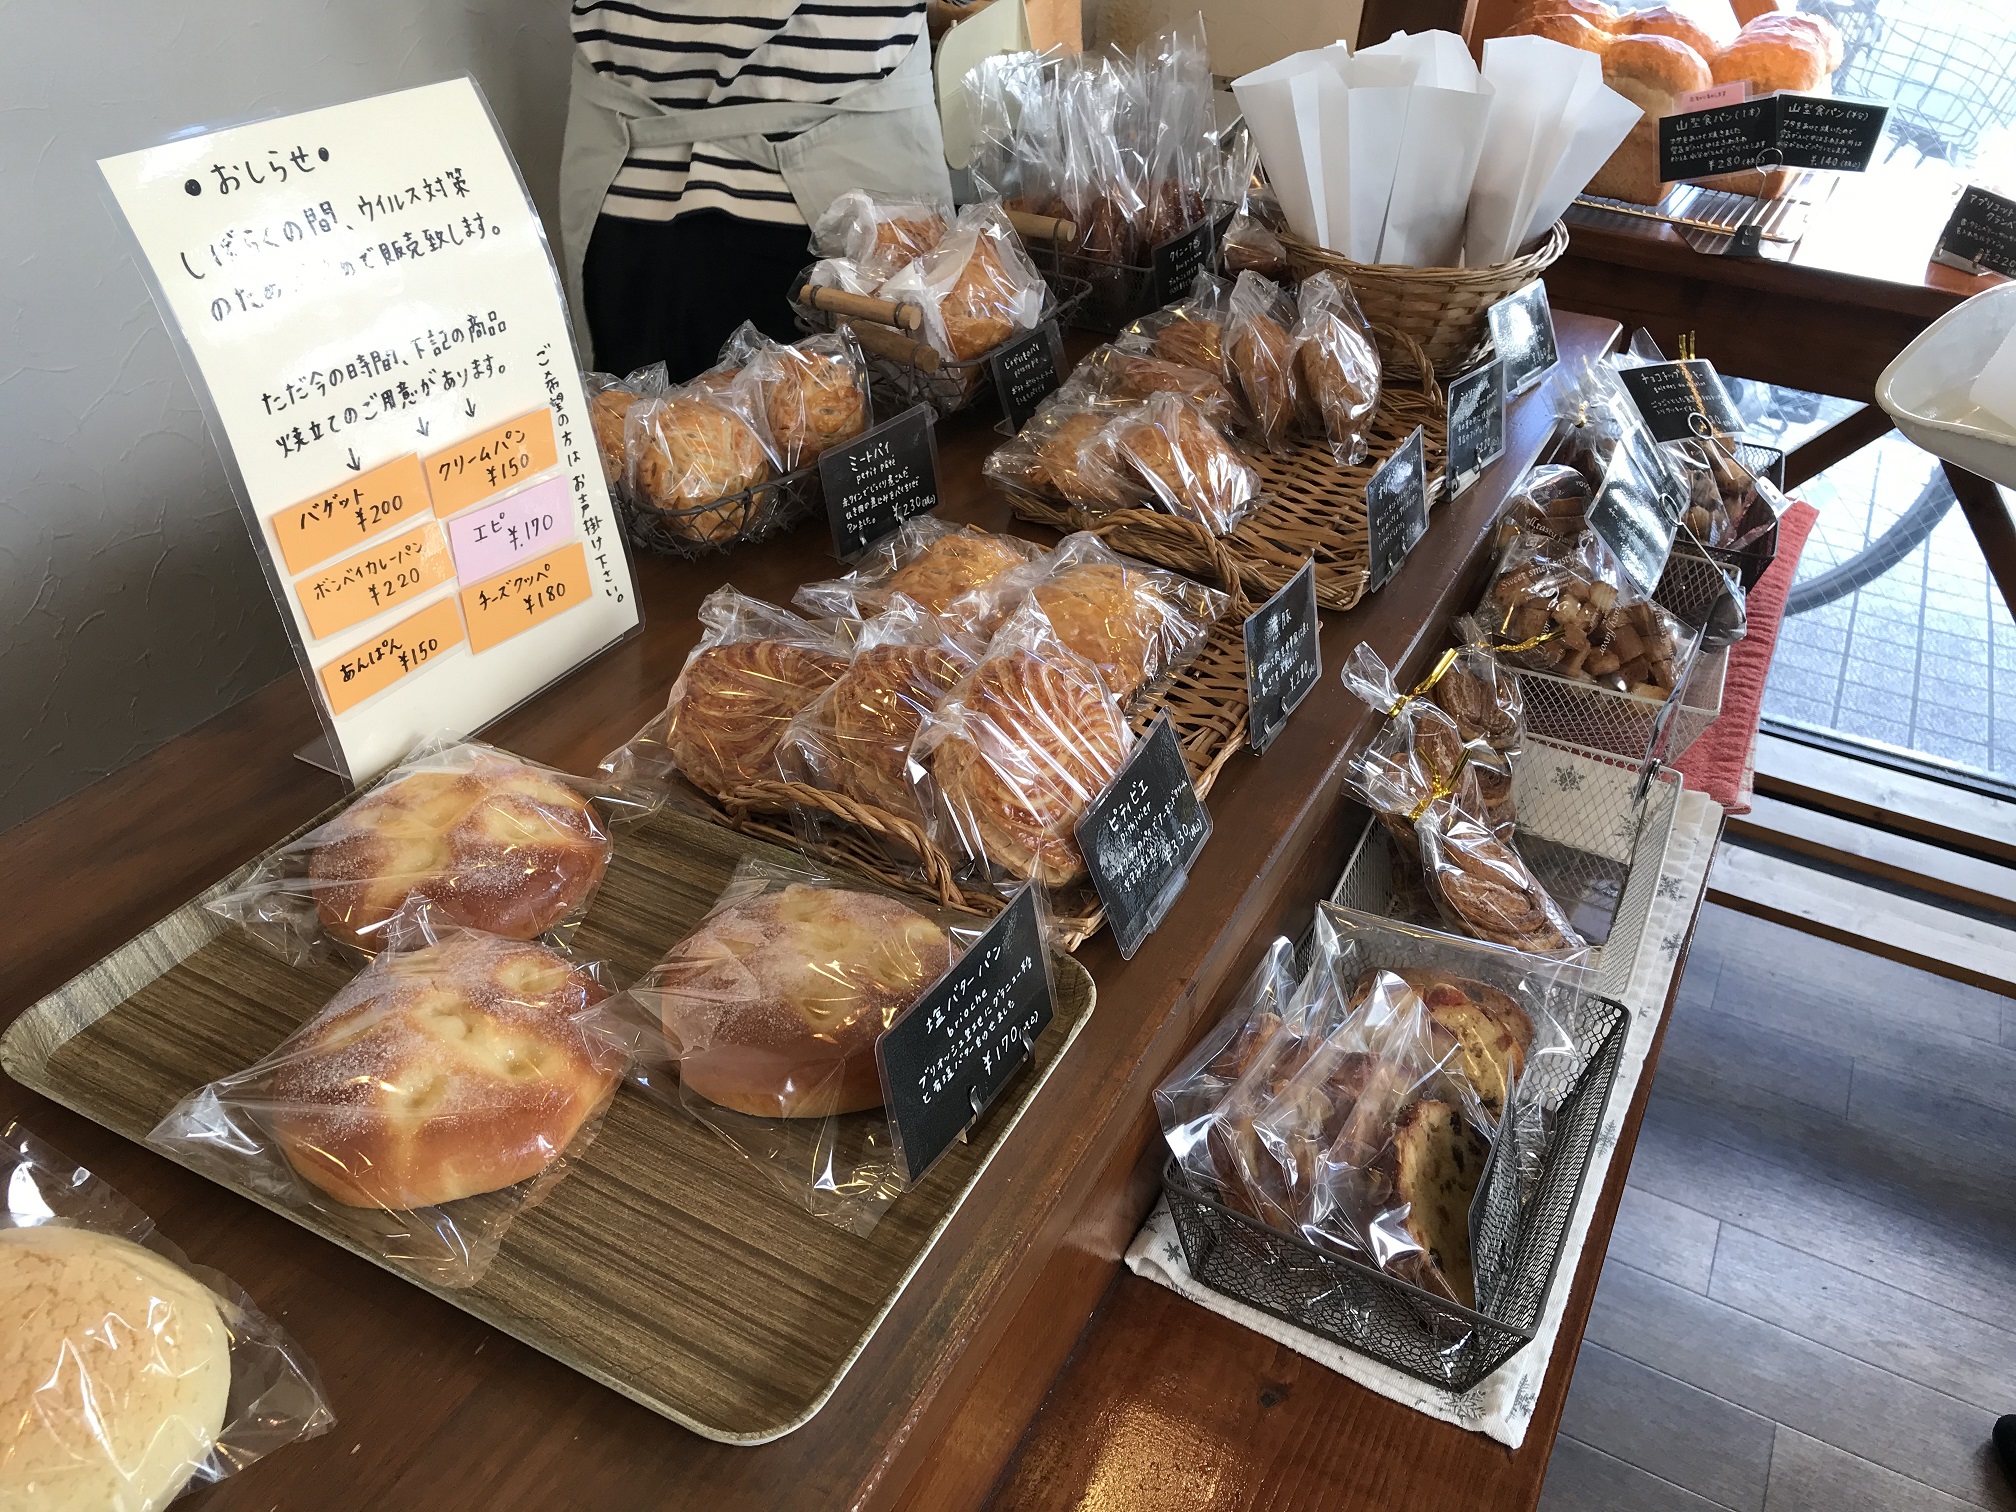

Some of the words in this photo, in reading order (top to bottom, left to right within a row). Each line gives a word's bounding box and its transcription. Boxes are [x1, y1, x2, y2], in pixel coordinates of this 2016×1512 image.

[210, 146, 317, 195] おしらせ
[180, 167, 471, 281] しばらくの間、ウイルス対策
[261, 310, 507, 416] ただ今の時間、下記の商品
[275, 353, 507, 458] 焼立てのご用意があります。
[438, 430, 525, 482] クリームパン
[485, 453, 529, 487] ¥150
[848, 441, 890, 472] ミートパイ
[300, 488, 365, 530] バゲット
[355, 494, 403, 533] ¥200
[472, 511, 506, 543] エピ
[313, 542, 422, 600] ボンベイカレーパン
[368, 567, 420, 606] ¥220
[478, 563, 551, 611] チーズクッペ
[522, 582, 566, 615] ¥180
[339, 638, 403, 683] あんぱん
[398, 638, 438, 673] ¥150
[1107, 779, 1149, 832] ピティビエ
[925, 946, 1001, 1035] 塩バターパン
[946, 988, 988, 1038] brioche
